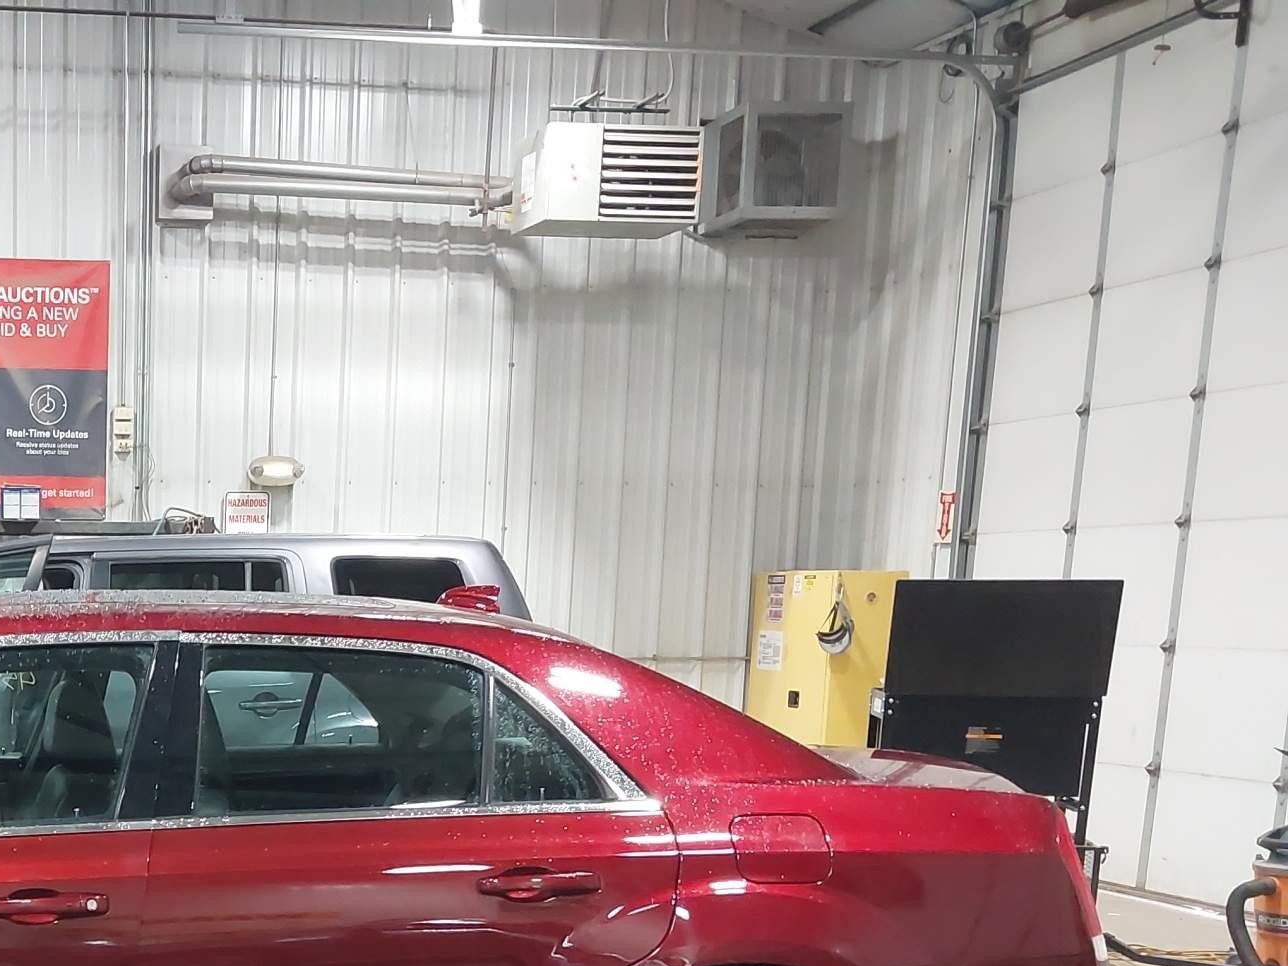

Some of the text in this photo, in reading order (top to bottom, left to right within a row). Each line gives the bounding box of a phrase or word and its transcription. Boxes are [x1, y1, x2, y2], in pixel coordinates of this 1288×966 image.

[27, 307, 38, 320] A
[43, 307, 79, 321] NEW
[19, 323, 32, 337] &
[36, 324, 68, 337] BUY
[6, 428, 88, 439] Real-Time Updates
[41, 488, 94, 498] get started!
[228, 499, 267, 507] HAZARDOUS
[229, 515, 265, 523] MATERIALS
